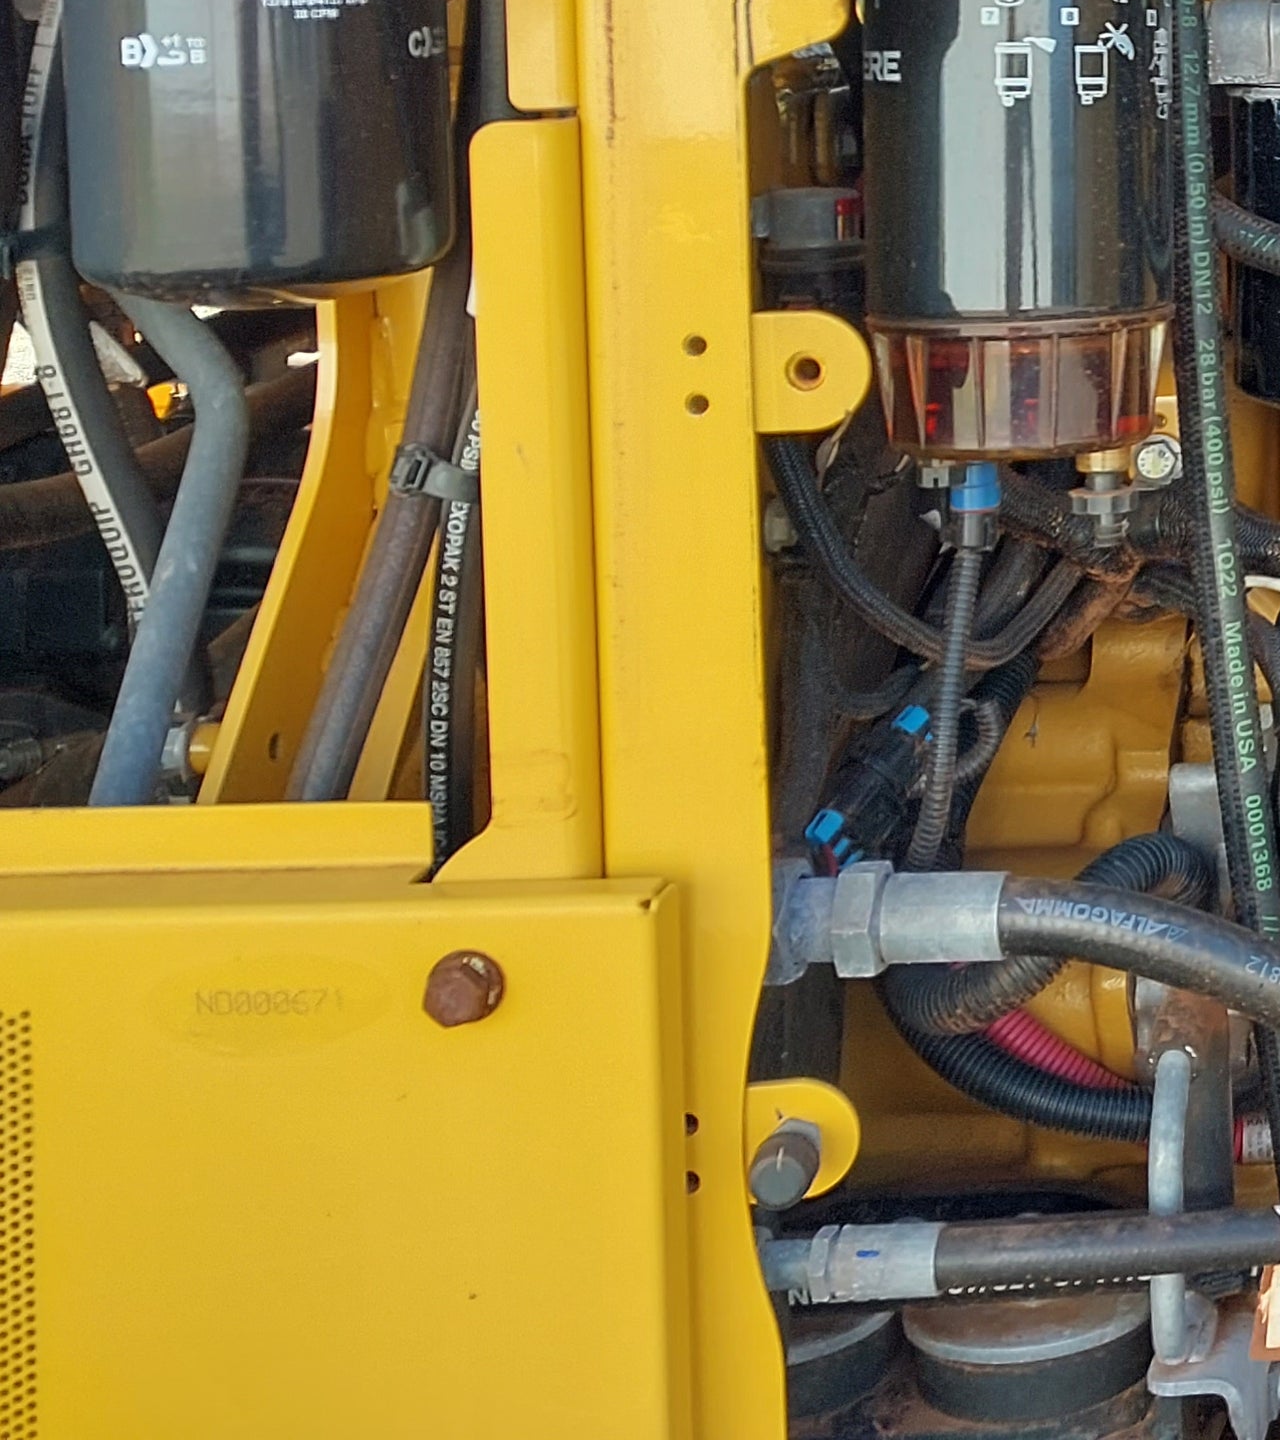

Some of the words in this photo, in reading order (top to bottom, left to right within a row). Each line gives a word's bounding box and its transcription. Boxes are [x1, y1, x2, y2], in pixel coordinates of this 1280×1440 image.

[1183, 50, 1200, 96] 12.7
[1185, 102, 1200, 145] mm
[1187, 153, 1207, 208] (0.50
[1190, 215, 1210, 245] in)
[1193, 251, 1214, 315] DN12
[1198, 338, 1217, 364] 28
[1200, 372, 1218, 410] bar
[1203, 416, 1225, 466] (400
[1206, 471, 1230, 515] psi)
[441, 501, 471, 572] EXOPAK
[440, 574, 456, 586] 2
[437, 589, 456, 614] ST
[435, 617, 454, 643] EN
[434, 646, 450, 678] 857
[1224, 620, 1245, 687] Made
[431, 680, 448, 716] 2SC
[1232, 691, 1250, 715] in
[430, 720, 448, 748] DN
[1235, 718, 1258, 773] USA
[429, 751, 447, 771] 10
[1244, 794, 1274, 892] 0001368
[1015, 897, 1170, 939] ALFAGOMMA
